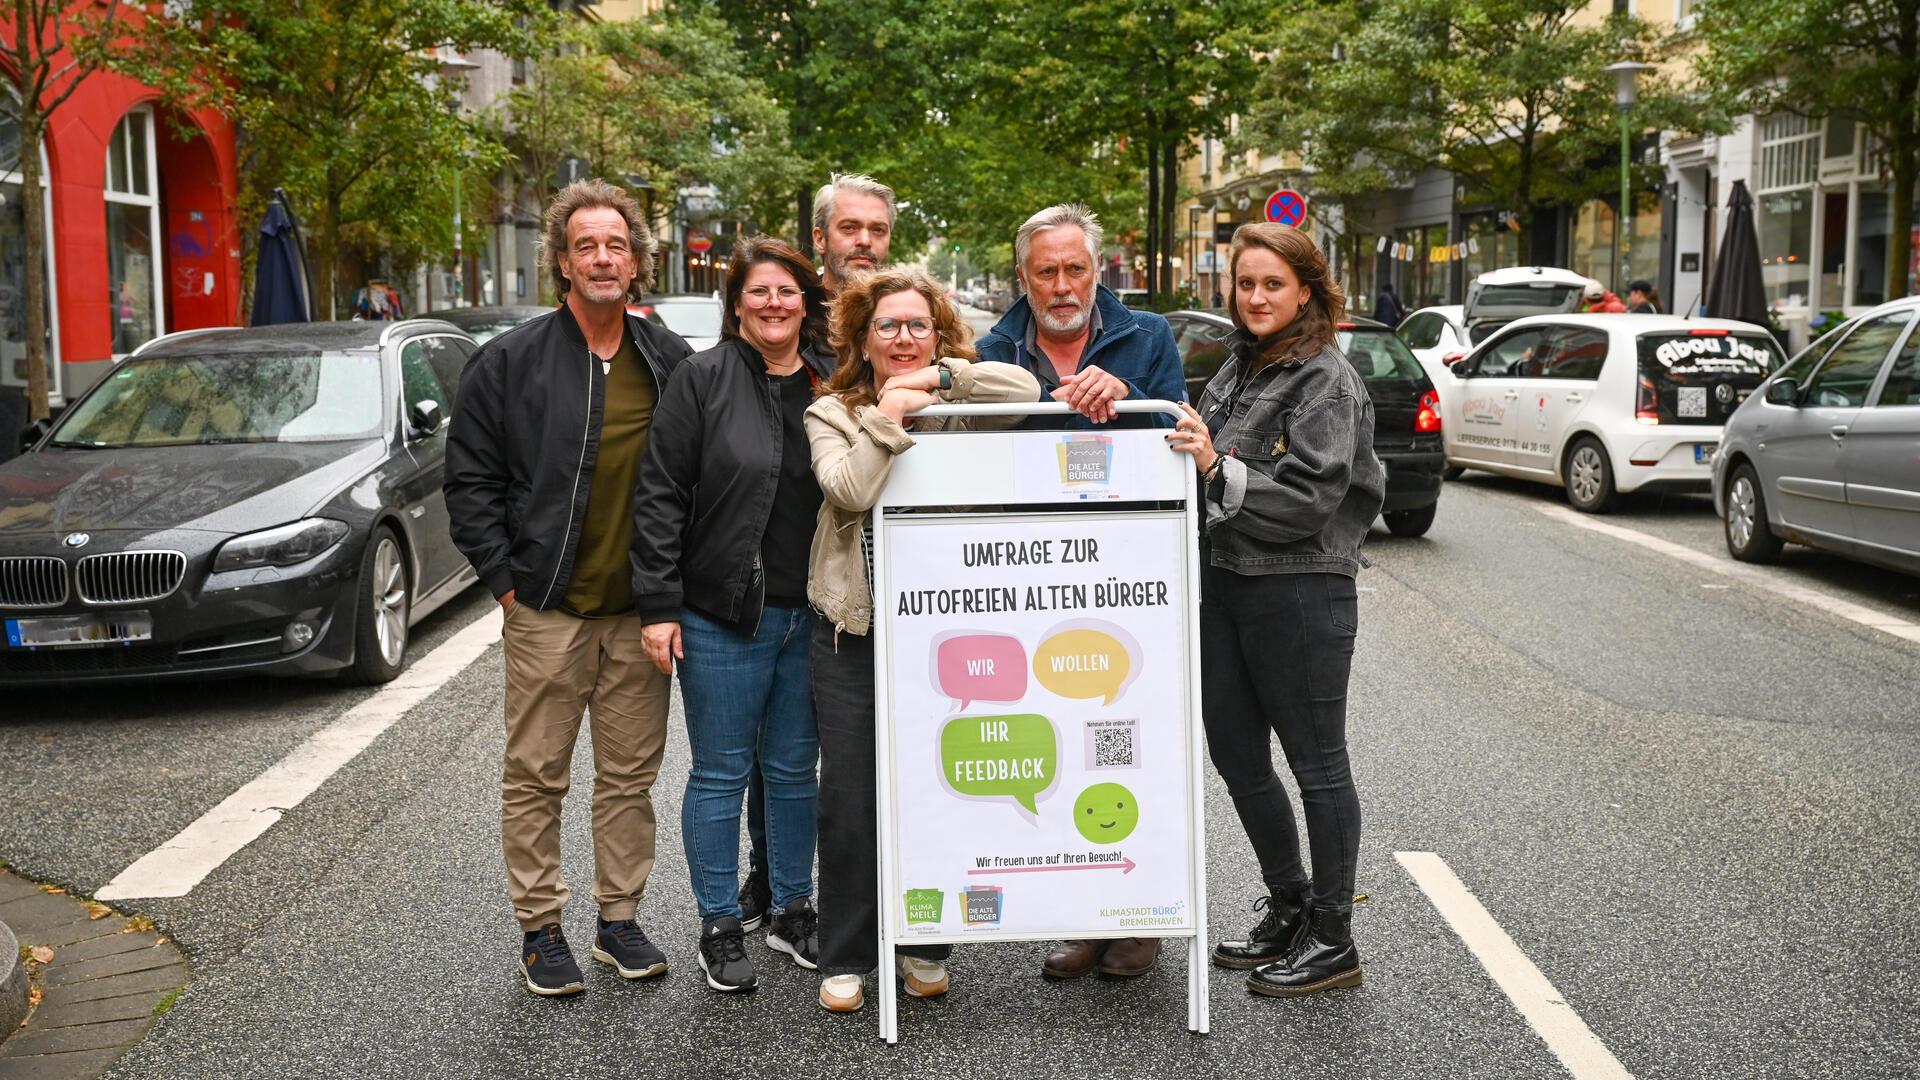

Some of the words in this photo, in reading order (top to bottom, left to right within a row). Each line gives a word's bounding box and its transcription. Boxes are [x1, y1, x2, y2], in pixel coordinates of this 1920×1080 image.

[1656, 338, 1721, 367] Abou
[1725, 336, 1770, 367] Jad
[1068, 463, 1081, 471] DIE
[1082, 462, 1100, 470] ALTE
[1068, 470, 1105, 480] BÜRGER
[963, 540, 1053, 567] UMFRAGE
[1060, 538, 1099, 563] ZUR
[897, 586, 1017, 616] AUTOFREIEN
[1024, 583, 1087, 611] ALTEN
[1094, 577, 1169, 608] BÜRGER
[966, 658, 996, 677] WIR
[1050, 654, 1109, 673] WOLLEN
[980, 721, 1009, 743] IHR
[955, 758, 1045, 782] FEEDBACK
[976, 856, 991, 868] Wir
[994, 856, 1025, 867] freuen
[1027, 856, 1043, 865] uns
[1045, 853, 1061, 864] auf
[1063, 852, 1086, 863] Ihren
[1088, 851, 1122, 862] Besuch!
[909, 910, 937, 919] MEILE
[1119, 917, 1184, 927] BREMERHAVEN
